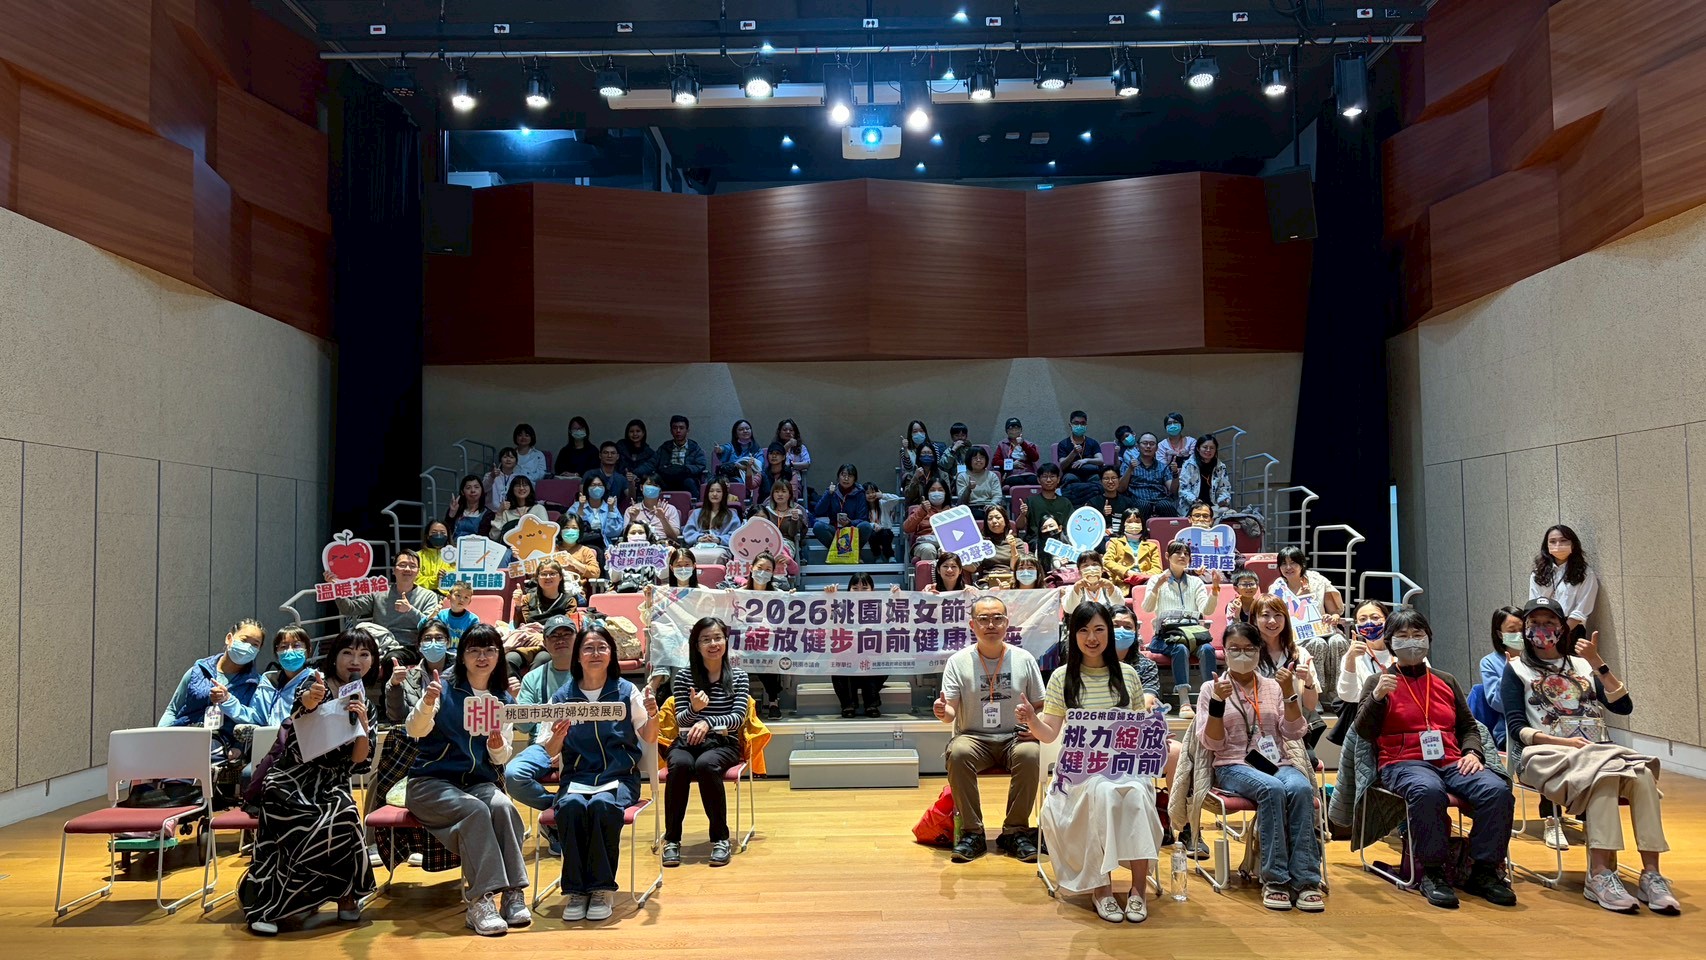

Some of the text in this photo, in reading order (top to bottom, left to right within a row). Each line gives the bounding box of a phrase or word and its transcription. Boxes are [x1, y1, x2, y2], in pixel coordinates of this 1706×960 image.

[316, 576, 389, 602] 溫暖補給
[440, 573, 503, 588] 線上倡議
[745, 598, 966, 625] 2026桃園婦女節
[504, 705, 623, 720] 桃園市政府婦幼發展局
[1067, 711, 1146, 721] 2026桃園婦女節
[1062, 725, 1166, 750] 桃力綻放
[1059, 750, 1162, 776] 健步向前
